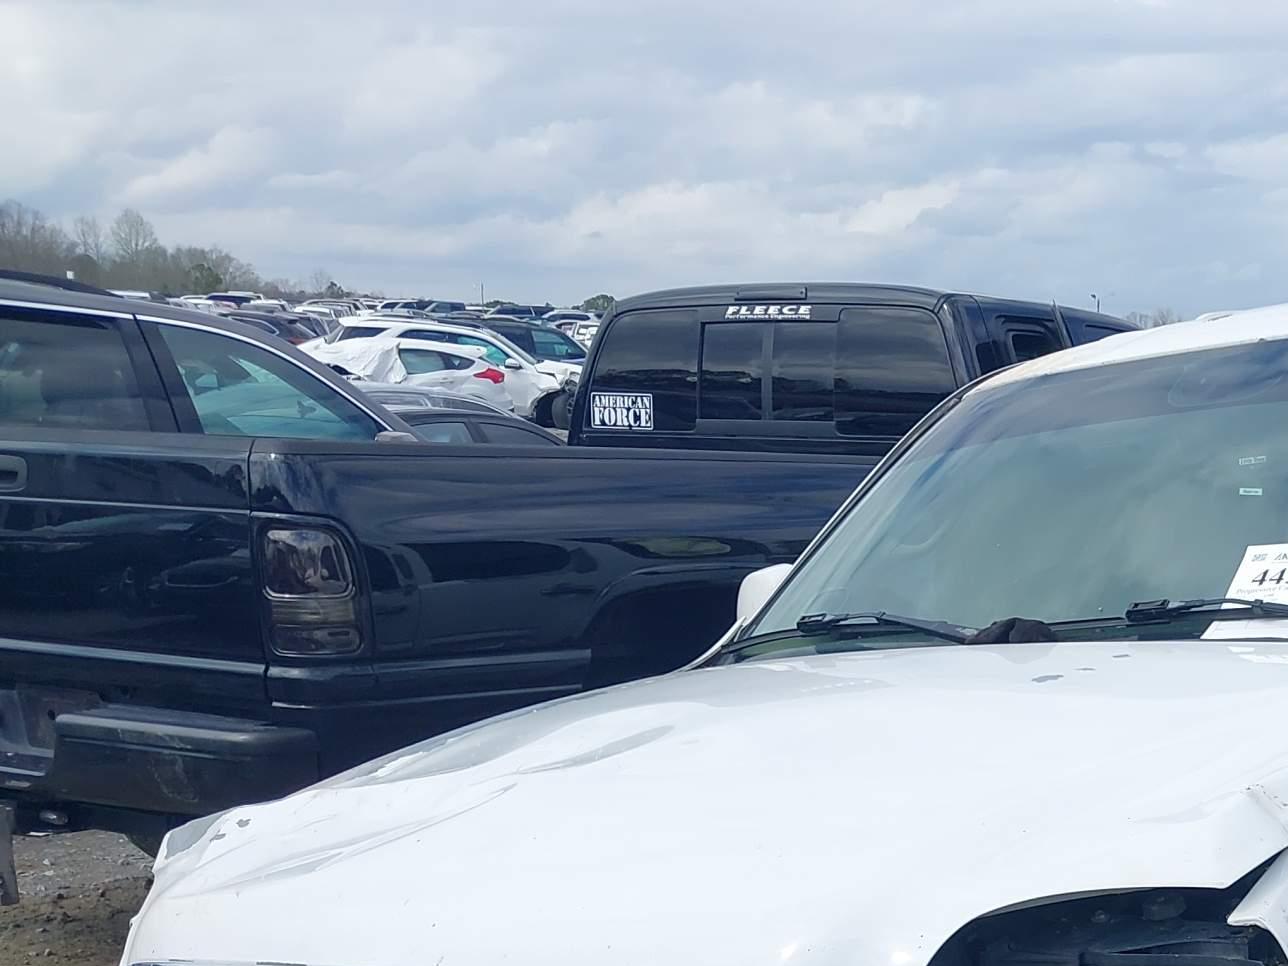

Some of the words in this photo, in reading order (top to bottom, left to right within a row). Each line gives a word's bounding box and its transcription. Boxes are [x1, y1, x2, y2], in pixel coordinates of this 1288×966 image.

[726, 305, 812, 314] FLEECE
[593, 395, 650, 408] AMERICAN
[594, 407, 651, 427] FORCE
